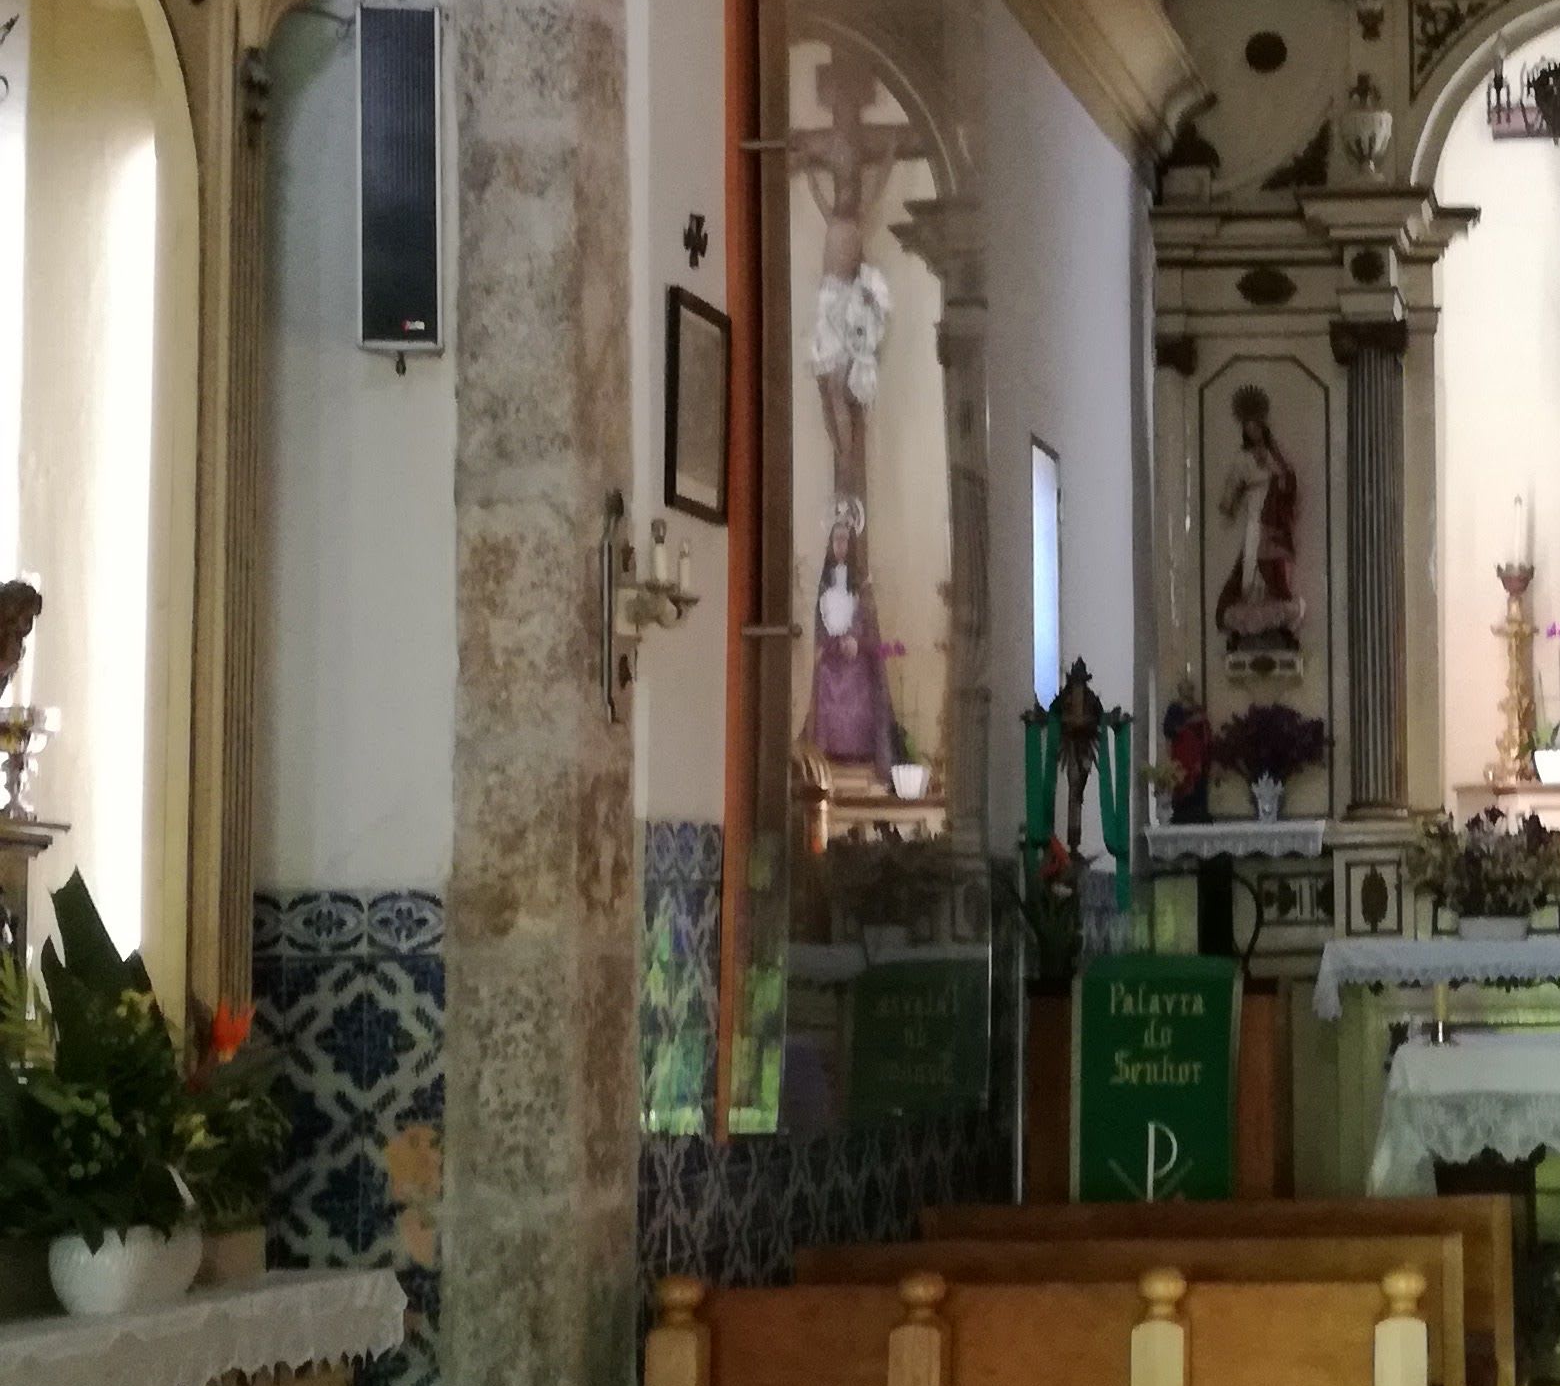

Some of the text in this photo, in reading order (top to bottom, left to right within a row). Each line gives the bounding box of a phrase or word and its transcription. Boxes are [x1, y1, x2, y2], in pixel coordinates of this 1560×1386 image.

[1109, 980, 1205, 1016] Palavra
[1143, 1018, 1173, 1049] do
[1110, 1049, 1203, 1086] Senhor
